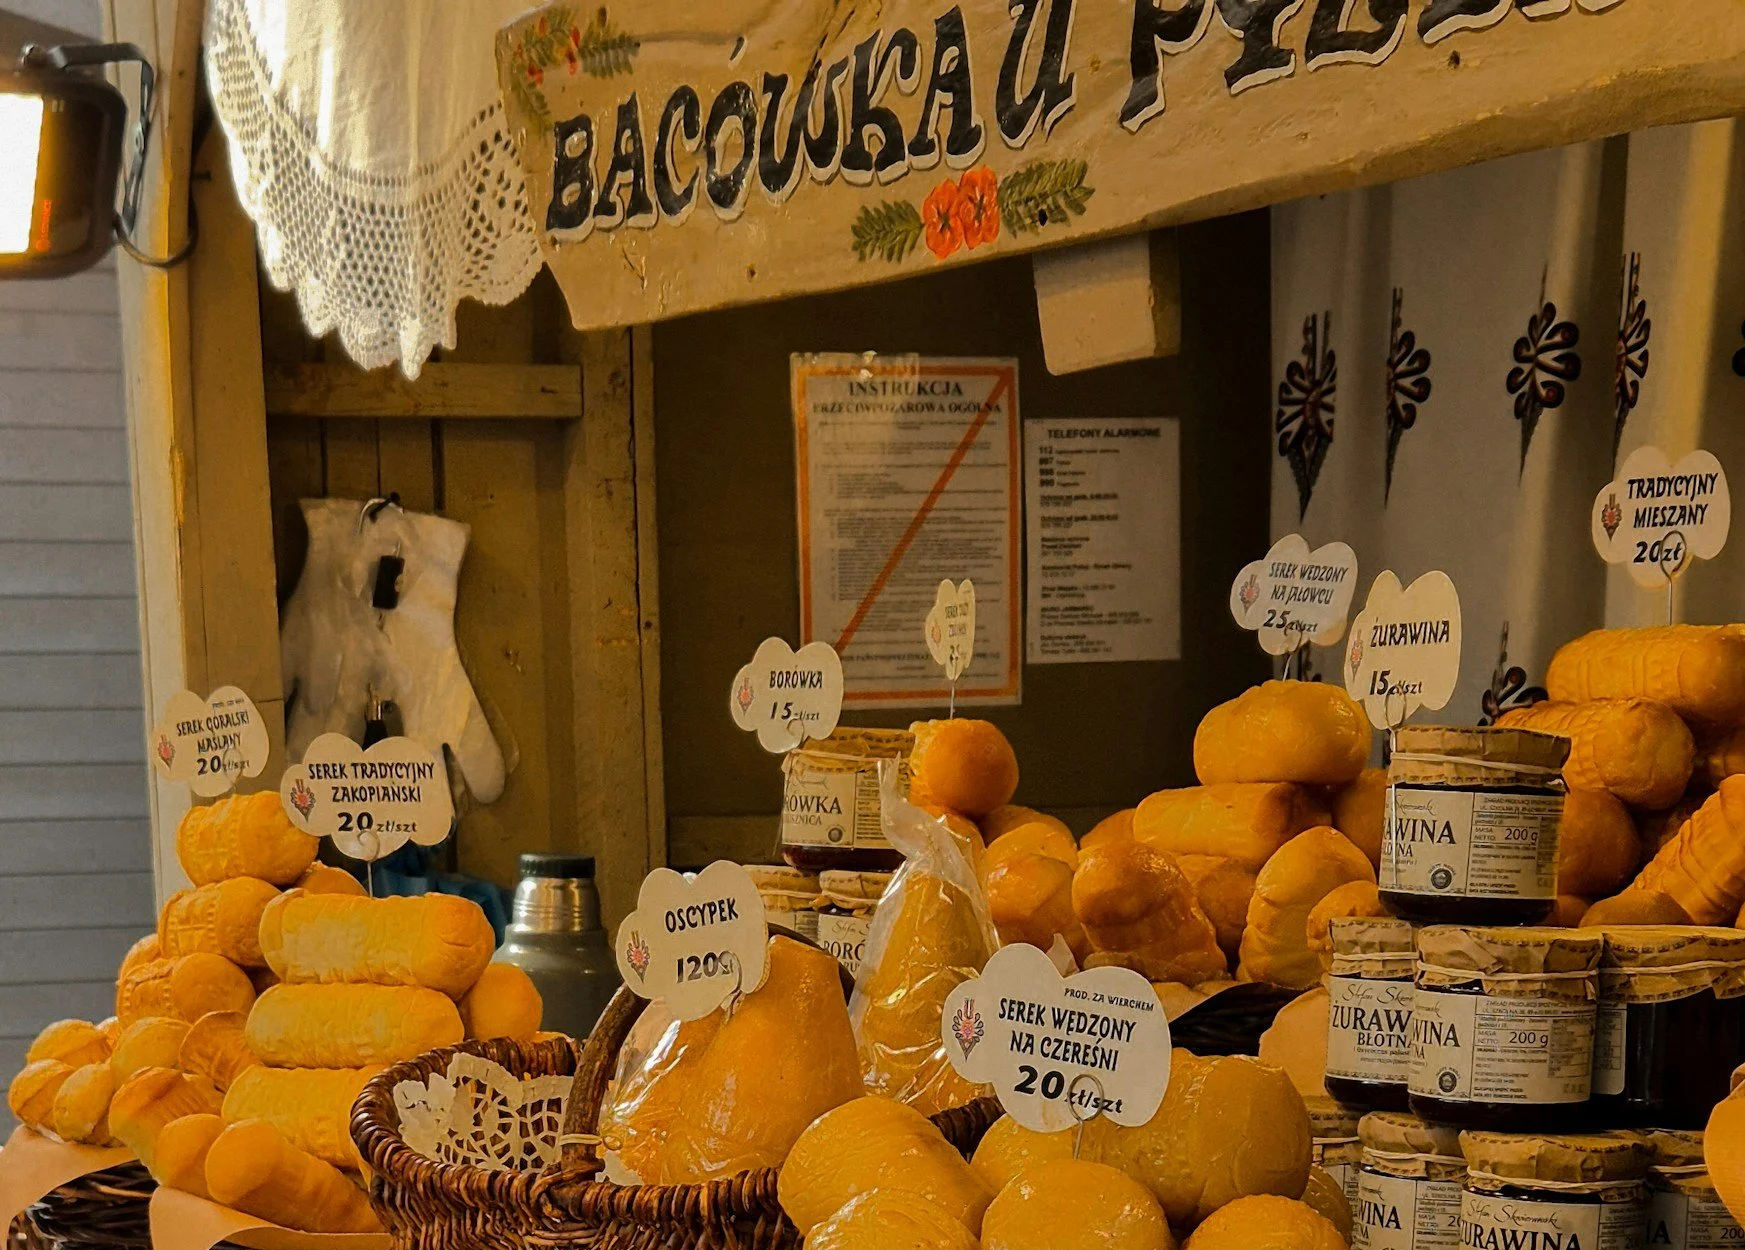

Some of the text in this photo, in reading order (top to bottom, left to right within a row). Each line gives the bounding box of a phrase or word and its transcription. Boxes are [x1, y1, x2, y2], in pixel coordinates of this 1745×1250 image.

[545, 4, 985, 243] BACÓWKA
[849, 380, 963, 397] INSTRUKCJA
[1047, 429, 1101, 439] TELEFONY
[1627, 473, 1719, 502] TRADYCYJNY
[1633, 504, 1709, 529] MIESZANY
[1633, 540, 1663, 564] 20
[1268, 562, 1299, 579] SEREK
[1270, 584, 1287, 601] NA
[1263, 609, 1291, 629] 25
[1369, 616, 1451, 648] ŻURAWINA
[769, 664, 823, 690] BORÓWKA
[1368, 669, 1392, 697] 15
[769, 701, 794, 720] 15
[176, 720, 205, 737] SEREK
[196, 755, 223, 776] 20
[308, 762, 435, 784] SEREK TRADYCYJNY
[331, 781, 422, 803] ZAKOPIAŃSKI
[337, 811, 374, 832] 20
[1504, 827, 1529, 841] 200
[664, 897, 739, 934] OSCYPEK
[676, 951, 720, 984] 120
[1064, 987, 1155, 1012] PROD. ZA WIERCHEM
[998, 997, 1137, 1043] SEREK WĘDZONY
[1009, 1030, 1119, 1072] NA CZEREŚNI
[1509, 1031, 1549, 1048] 200 g
[1013, 1064, 1065, 1100] 20
